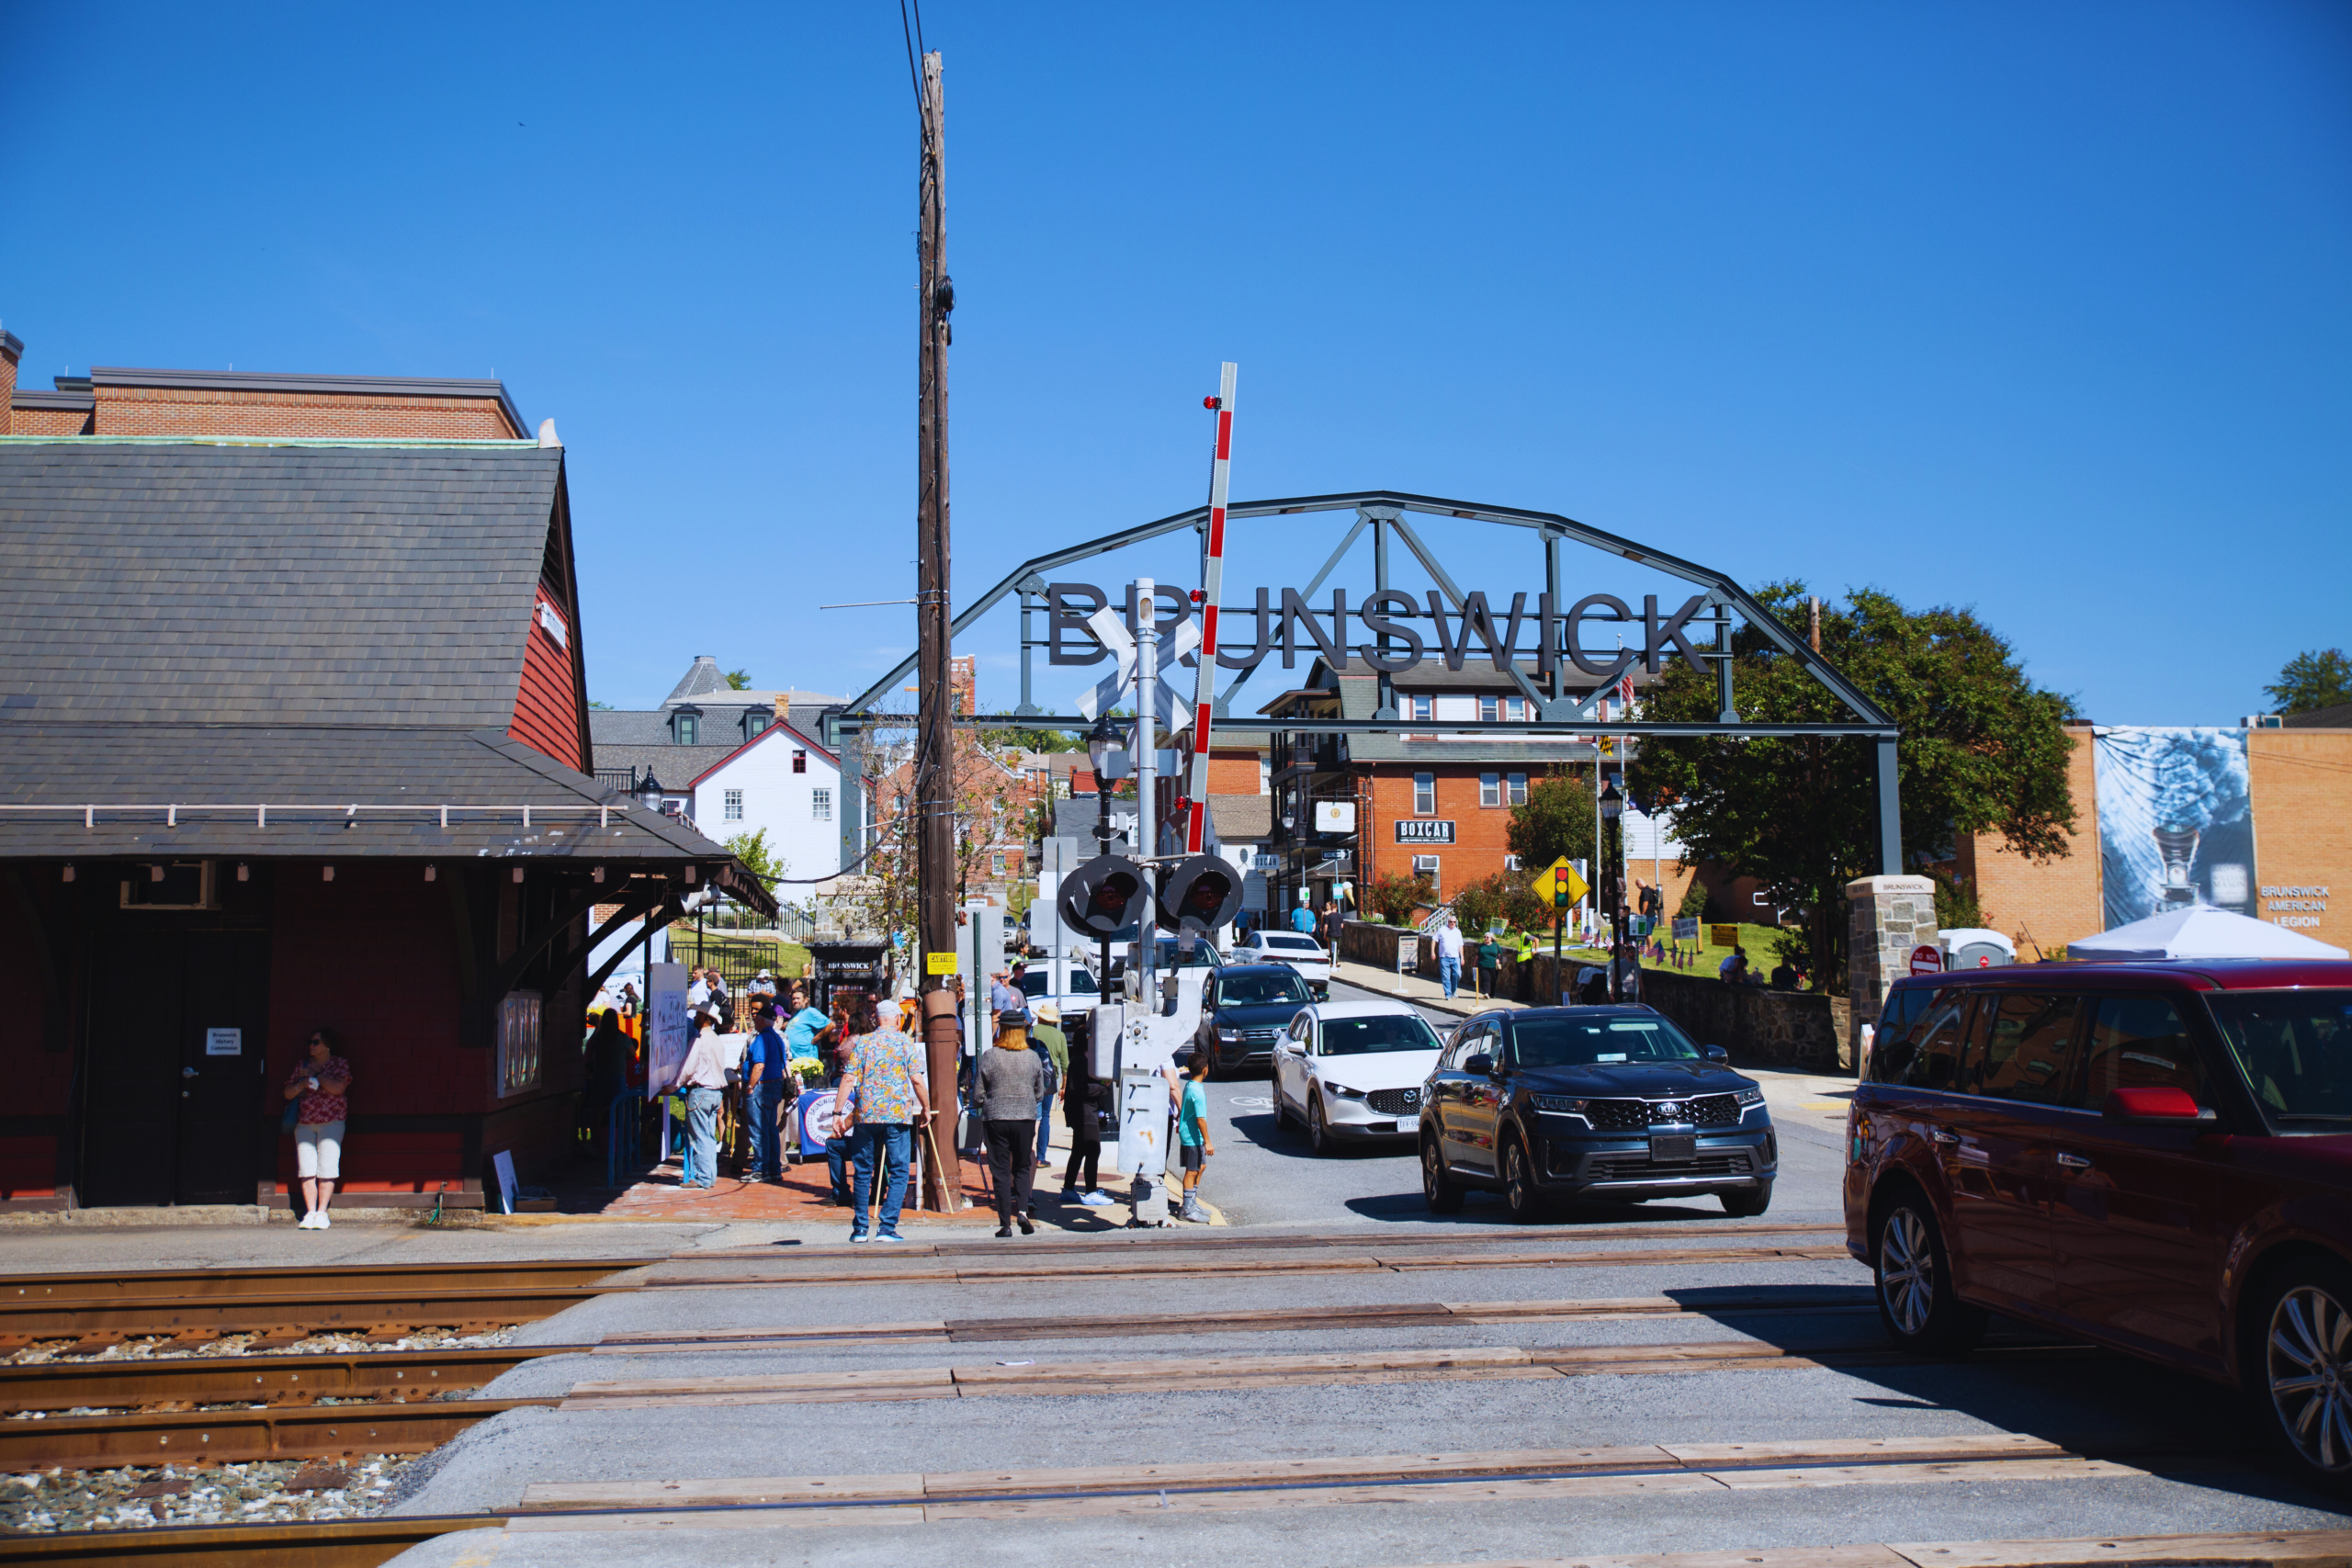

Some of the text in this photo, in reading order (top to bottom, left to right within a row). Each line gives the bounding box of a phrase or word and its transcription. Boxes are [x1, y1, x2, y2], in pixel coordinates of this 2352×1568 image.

[1049, 582, 1712, 676] BRUNSWICK
[1400, 822, 1449, 838] BOXCAR
[1250, 857, 1277, 866] BOXCAR
[2261, 886, 2330, 898] BRUNSWICK
[2267, 901, 2326, 912] AMERICAN
[2273, 916, 2321, 928] LEGION
[1915, 952, 1923, 960] DO
[1660, 1104, 1678, 1113] KIA
